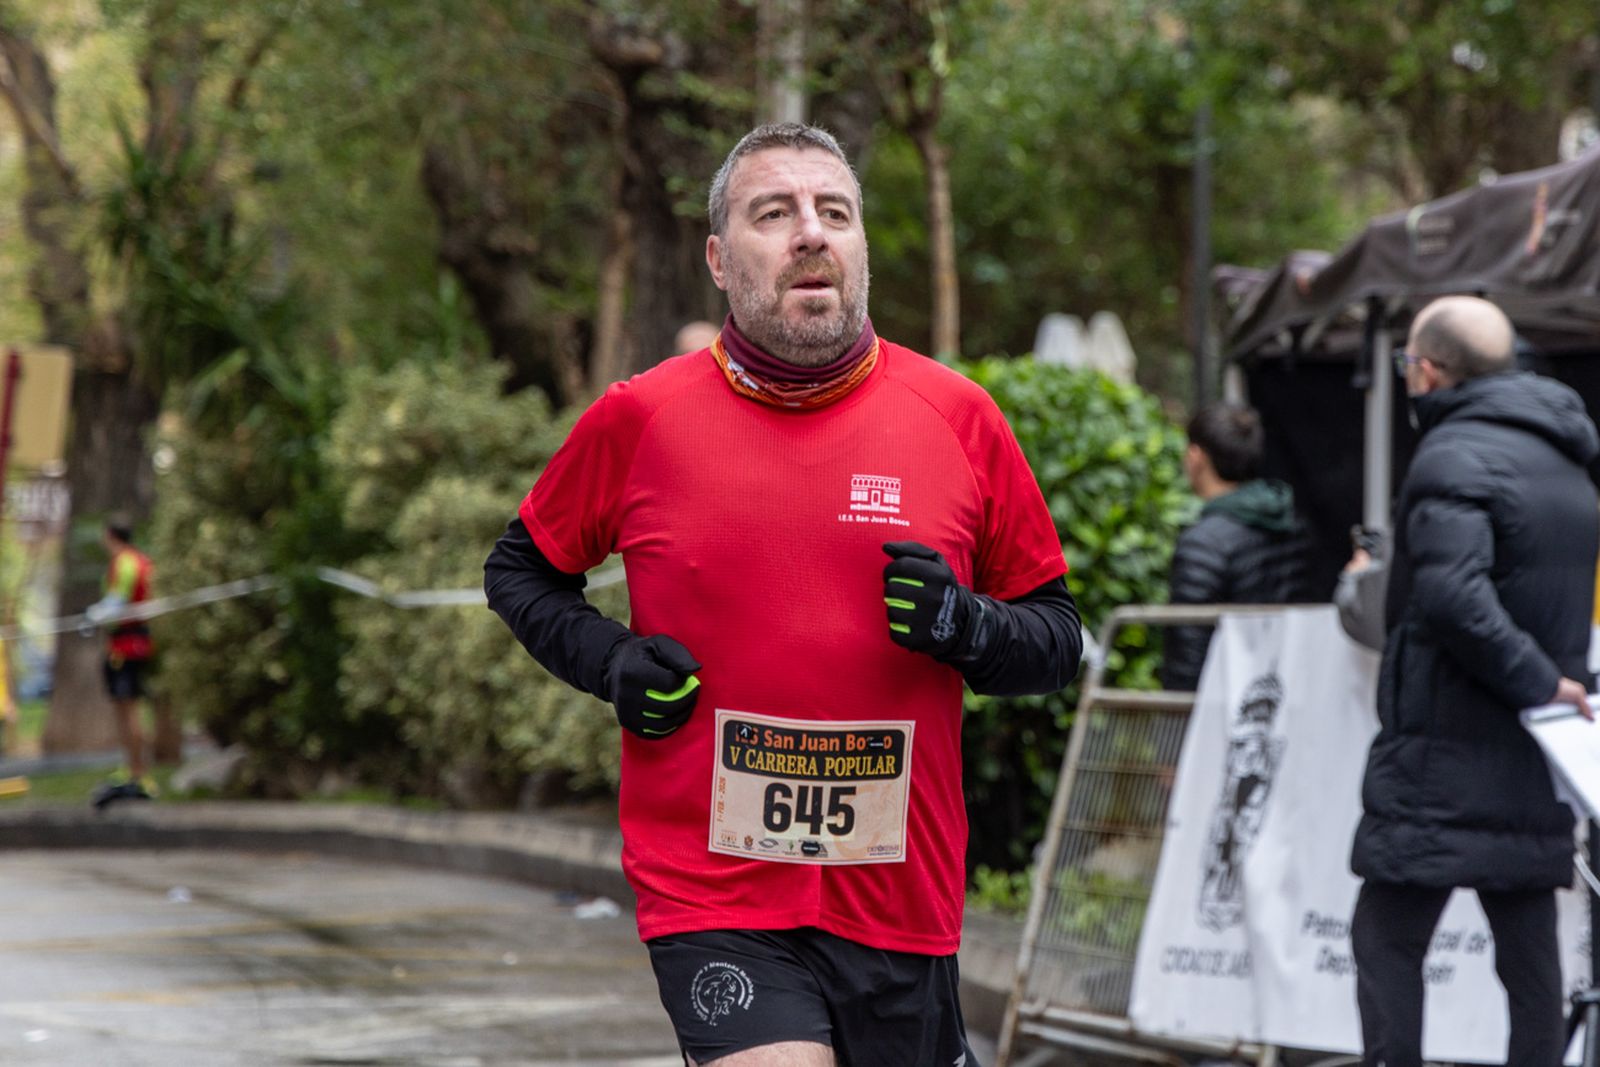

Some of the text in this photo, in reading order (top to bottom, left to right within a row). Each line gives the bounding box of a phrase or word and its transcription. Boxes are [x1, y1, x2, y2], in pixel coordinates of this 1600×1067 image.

[855, 514, 869, 522] San
[870, 515, 887, 524] Juan
[764, 729, 794, 750] San
[799, 733, 840, 751] Juan
[846, 733, 893, 751] Boo
[729, 745, 896, 777] V CARRERA POPULAR
[763, 782, 857, 837] 645
